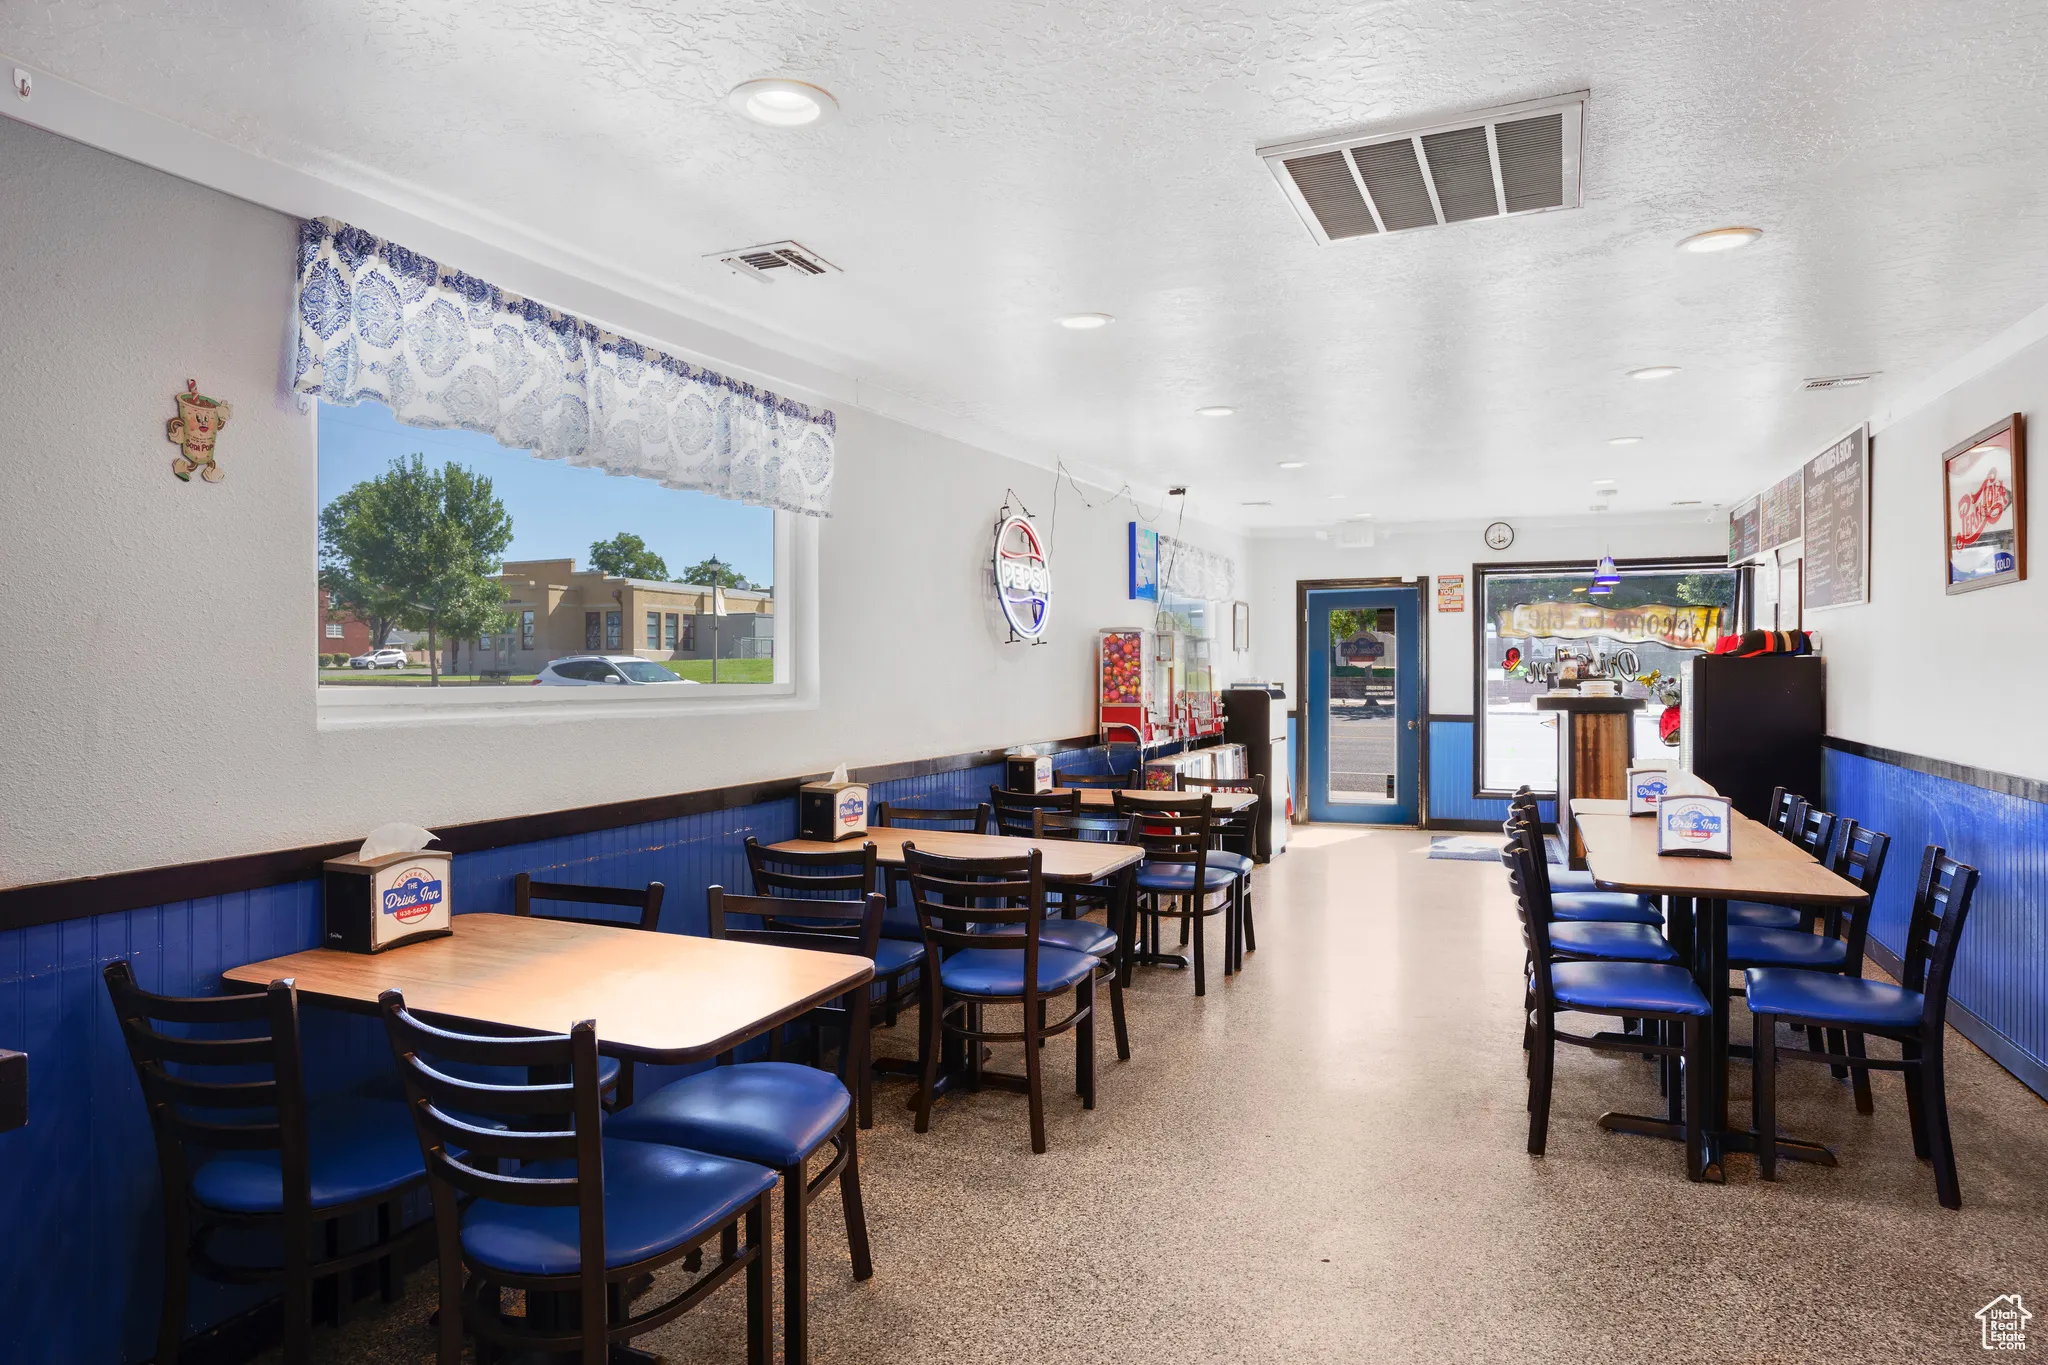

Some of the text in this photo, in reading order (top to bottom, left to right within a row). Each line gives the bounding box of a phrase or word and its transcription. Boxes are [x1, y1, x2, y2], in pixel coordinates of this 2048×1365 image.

[186, 438, 201, 452] SODA
[201, 443, 214, 452] POP
[1995, 557, 2011, 571] COLD
[1001, 560, 1048, 595] PEPSI
[1669, 817, 1720, 830] Drive Inn
[407, 882, 418, 890] THE
[385, 886, 440, 909] Drive Inn
[399, 906, 428, 917] 438-5600
